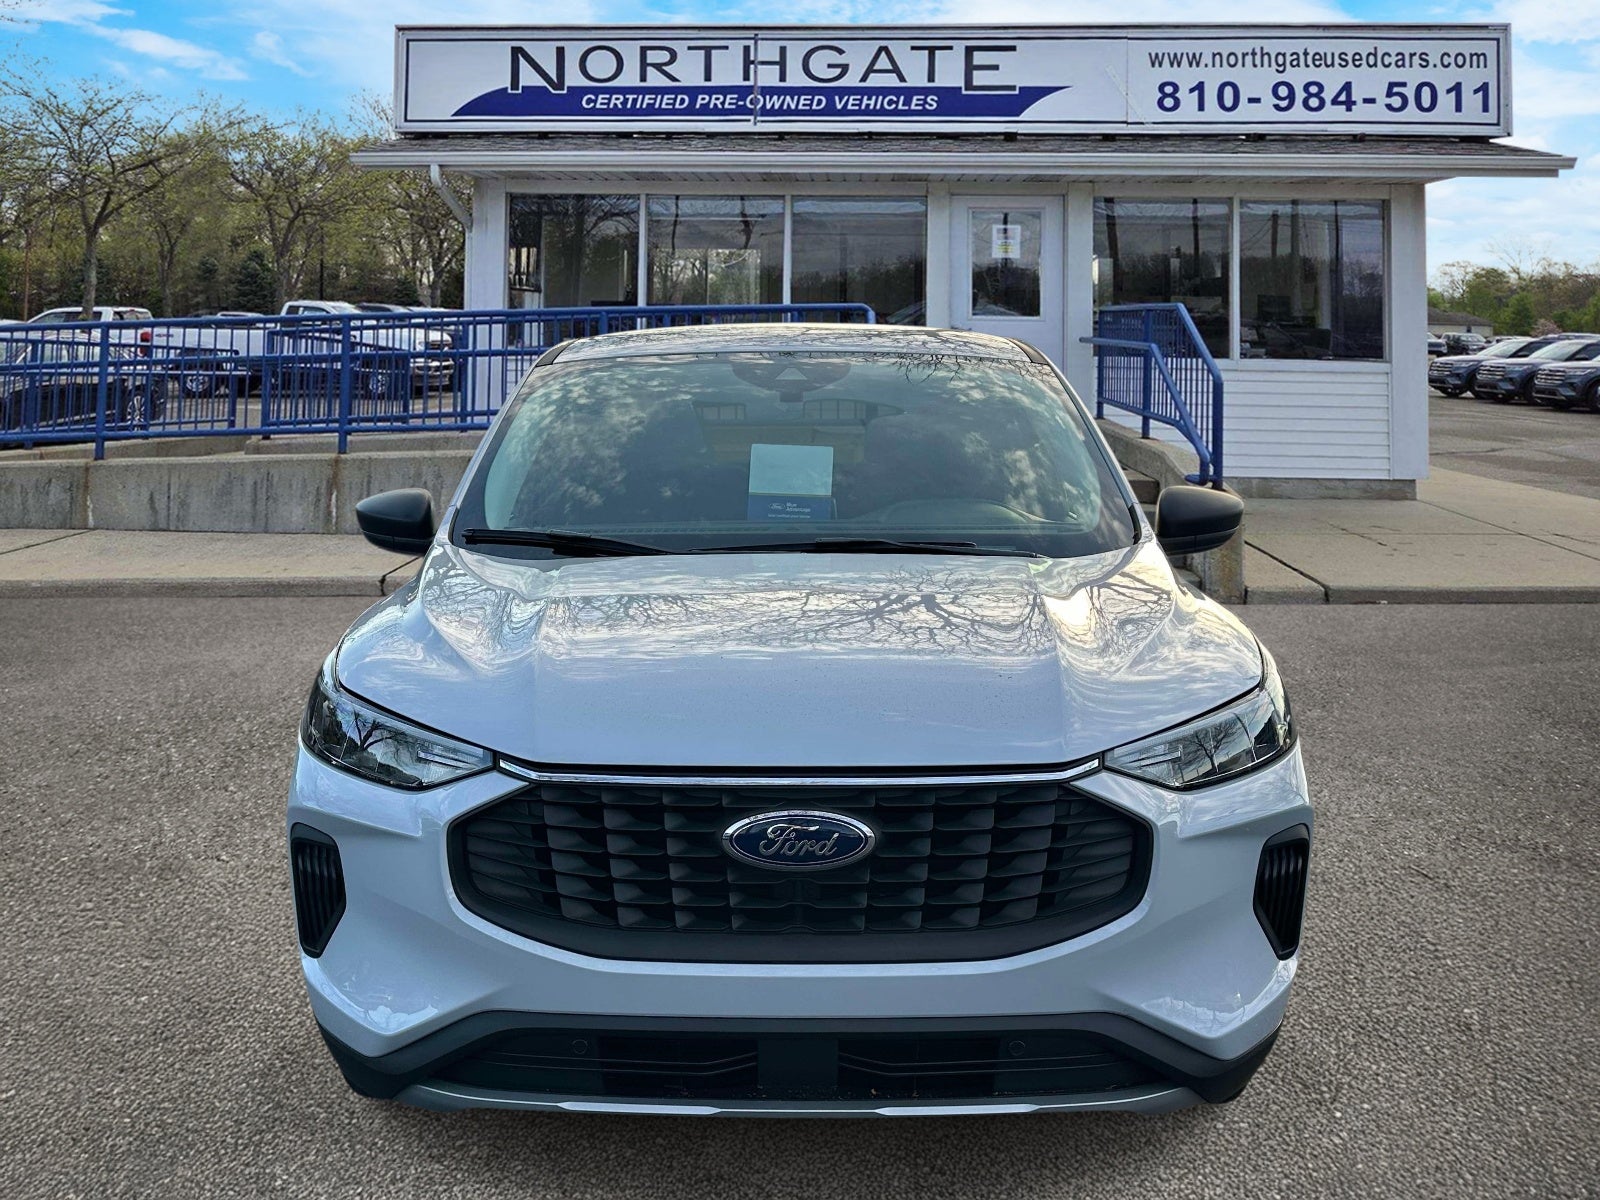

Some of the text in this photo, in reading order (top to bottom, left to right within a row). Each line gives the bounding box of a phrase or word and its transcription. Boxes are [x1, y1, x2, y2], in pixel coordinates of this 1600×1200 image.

[510, 45, 1017, 92] NORTHGATE
[1148, 47, 1488, 73] www.northgateusedcars.com
[581, 95, 938, 111] CERTIFIED PRE-OWNED VEHICLES
[1156, 81, 1490, 113] 810-984-5011
[760, 823, 840, 856] Ford
